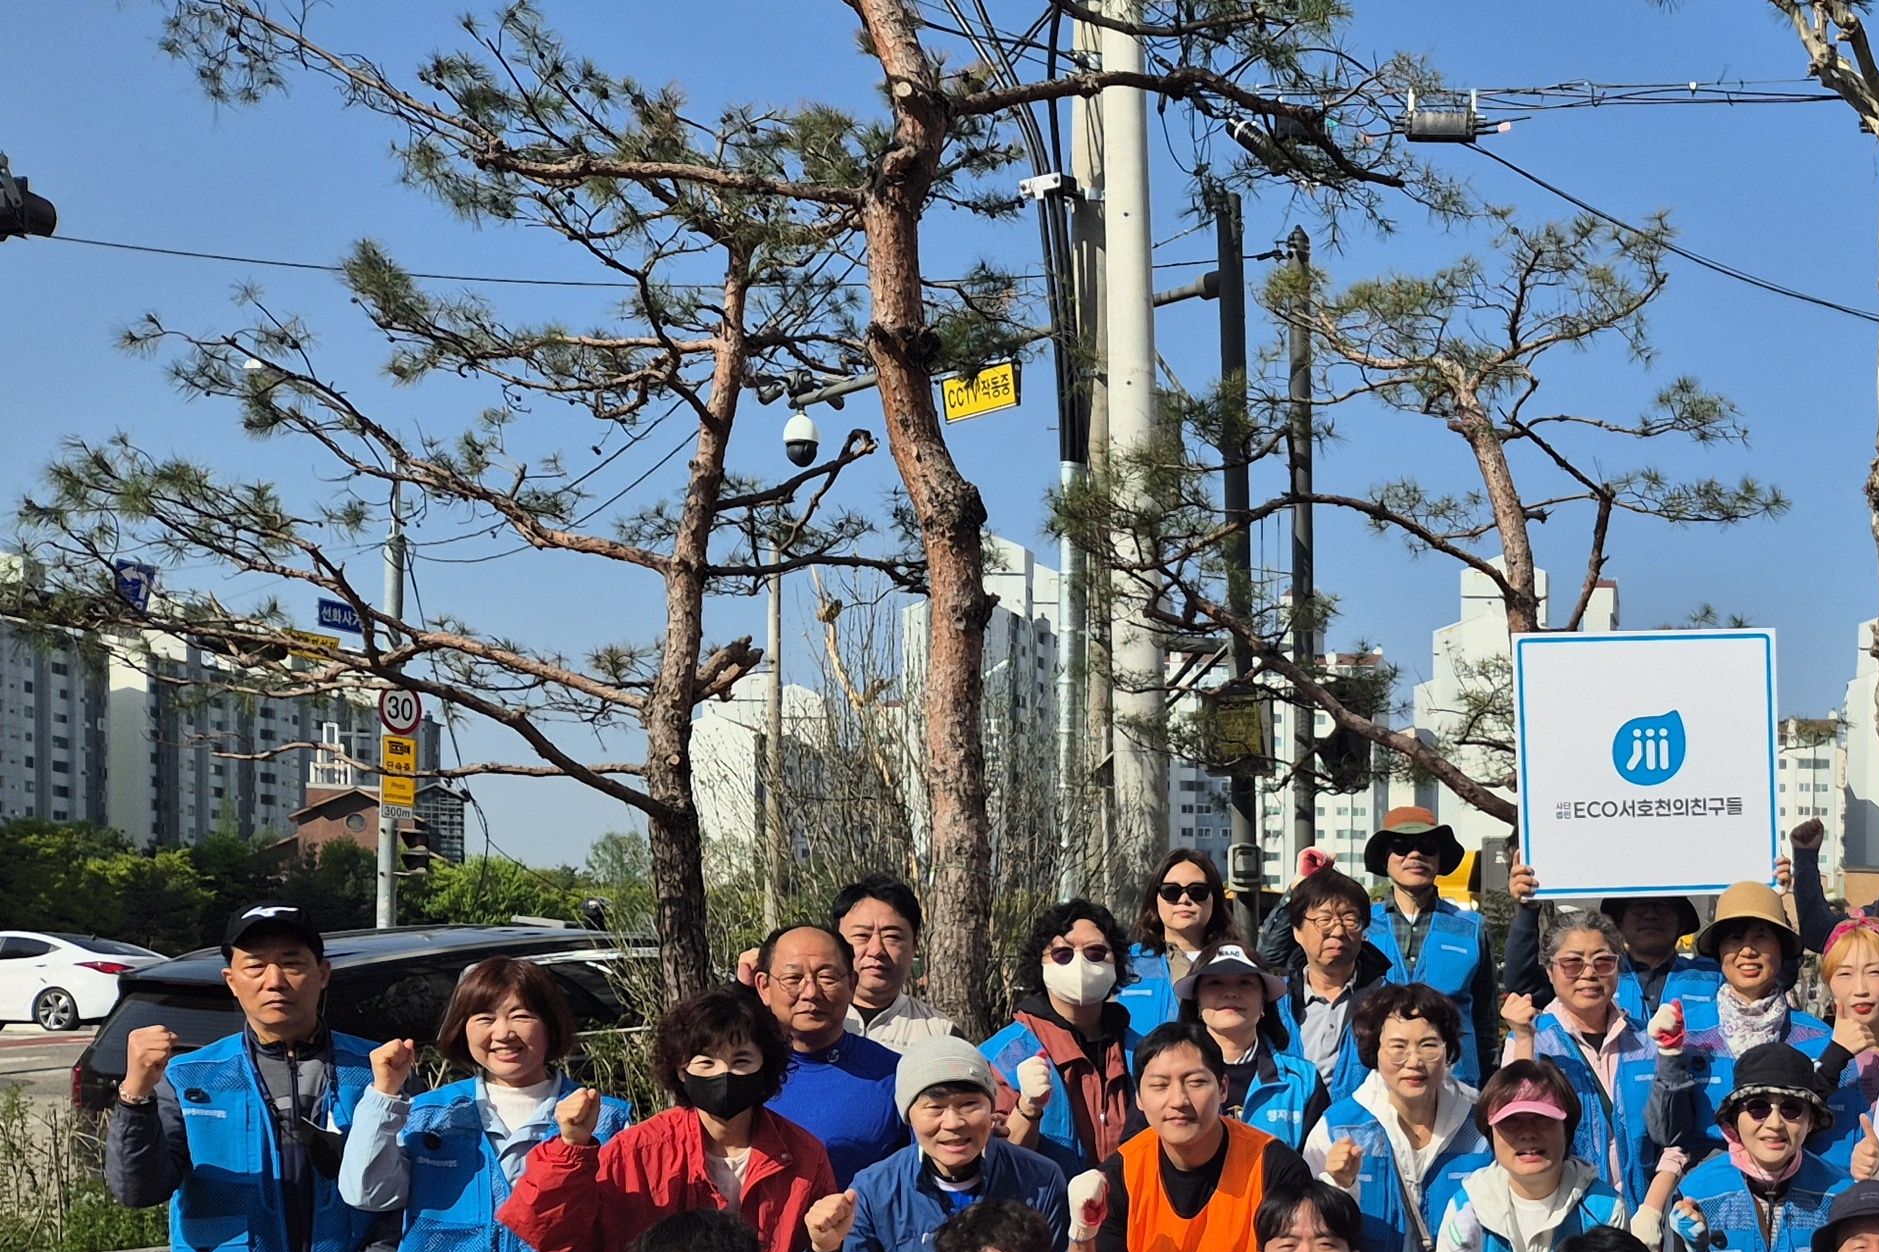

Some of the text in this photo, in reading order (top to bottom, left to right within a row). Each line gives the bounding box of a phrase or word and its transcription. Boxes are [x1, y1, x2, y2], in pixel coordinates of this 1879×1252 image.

[321, 605, 363, 629] 선화사거
[387, 695, 413, 721] 30
[384, 806, 411, 818] 300m
[1573, 797, 1743, 819] ECO서호천의친구들
